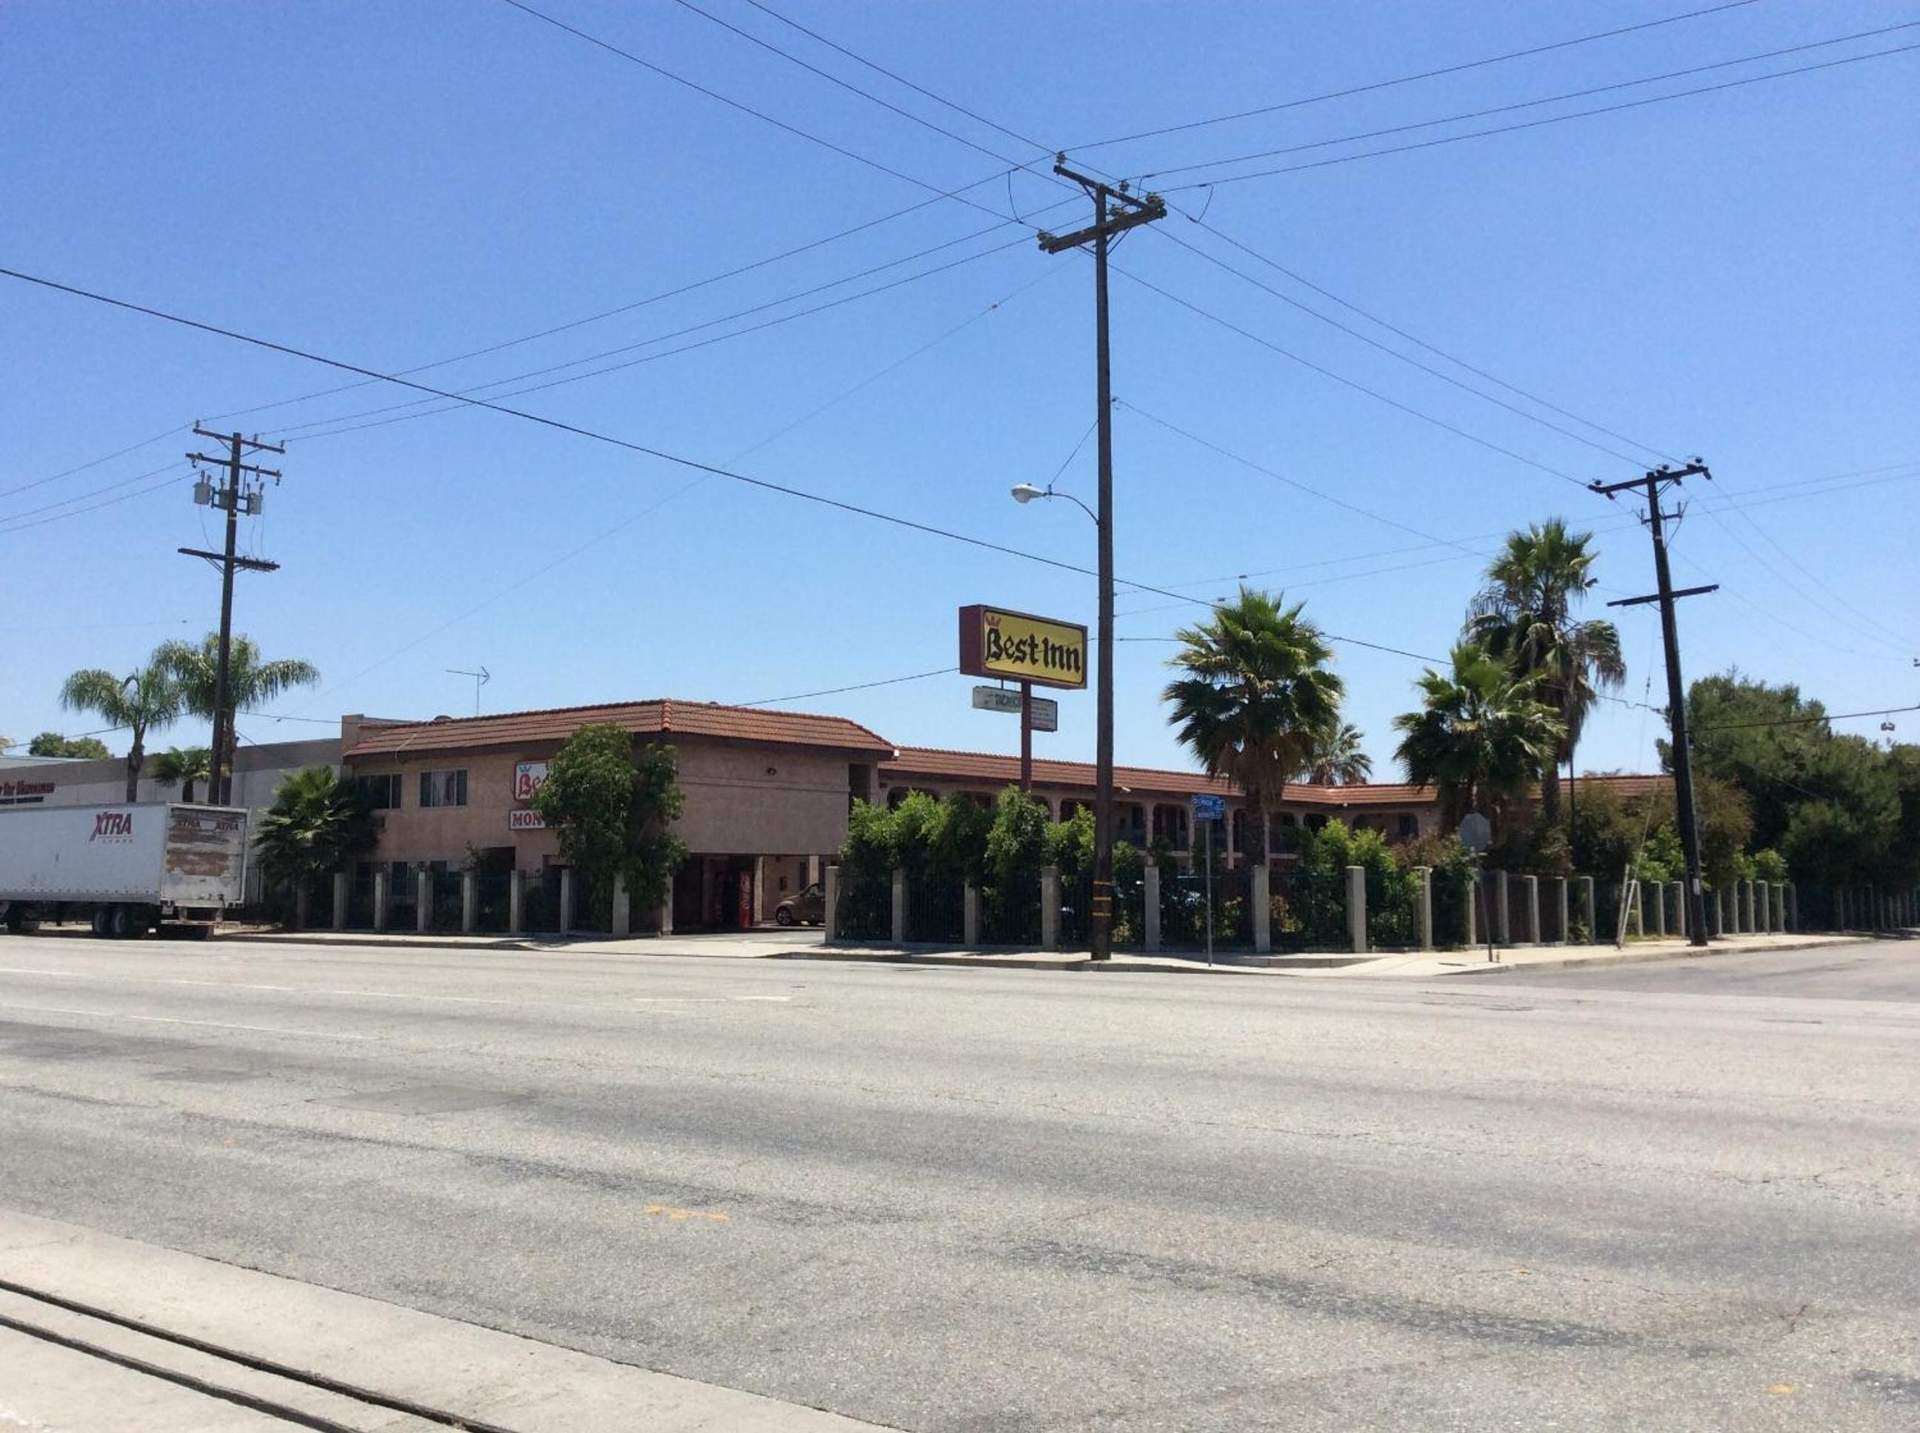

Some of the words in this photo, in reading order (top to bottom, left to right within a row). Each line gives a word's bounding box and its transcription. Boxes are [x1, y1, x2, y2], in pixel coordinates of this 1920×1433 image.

[985, 627, 1038, 666] Best
[1041, 636, 1081, 673] Inn
[89, 811, 132, 841] XTRA
